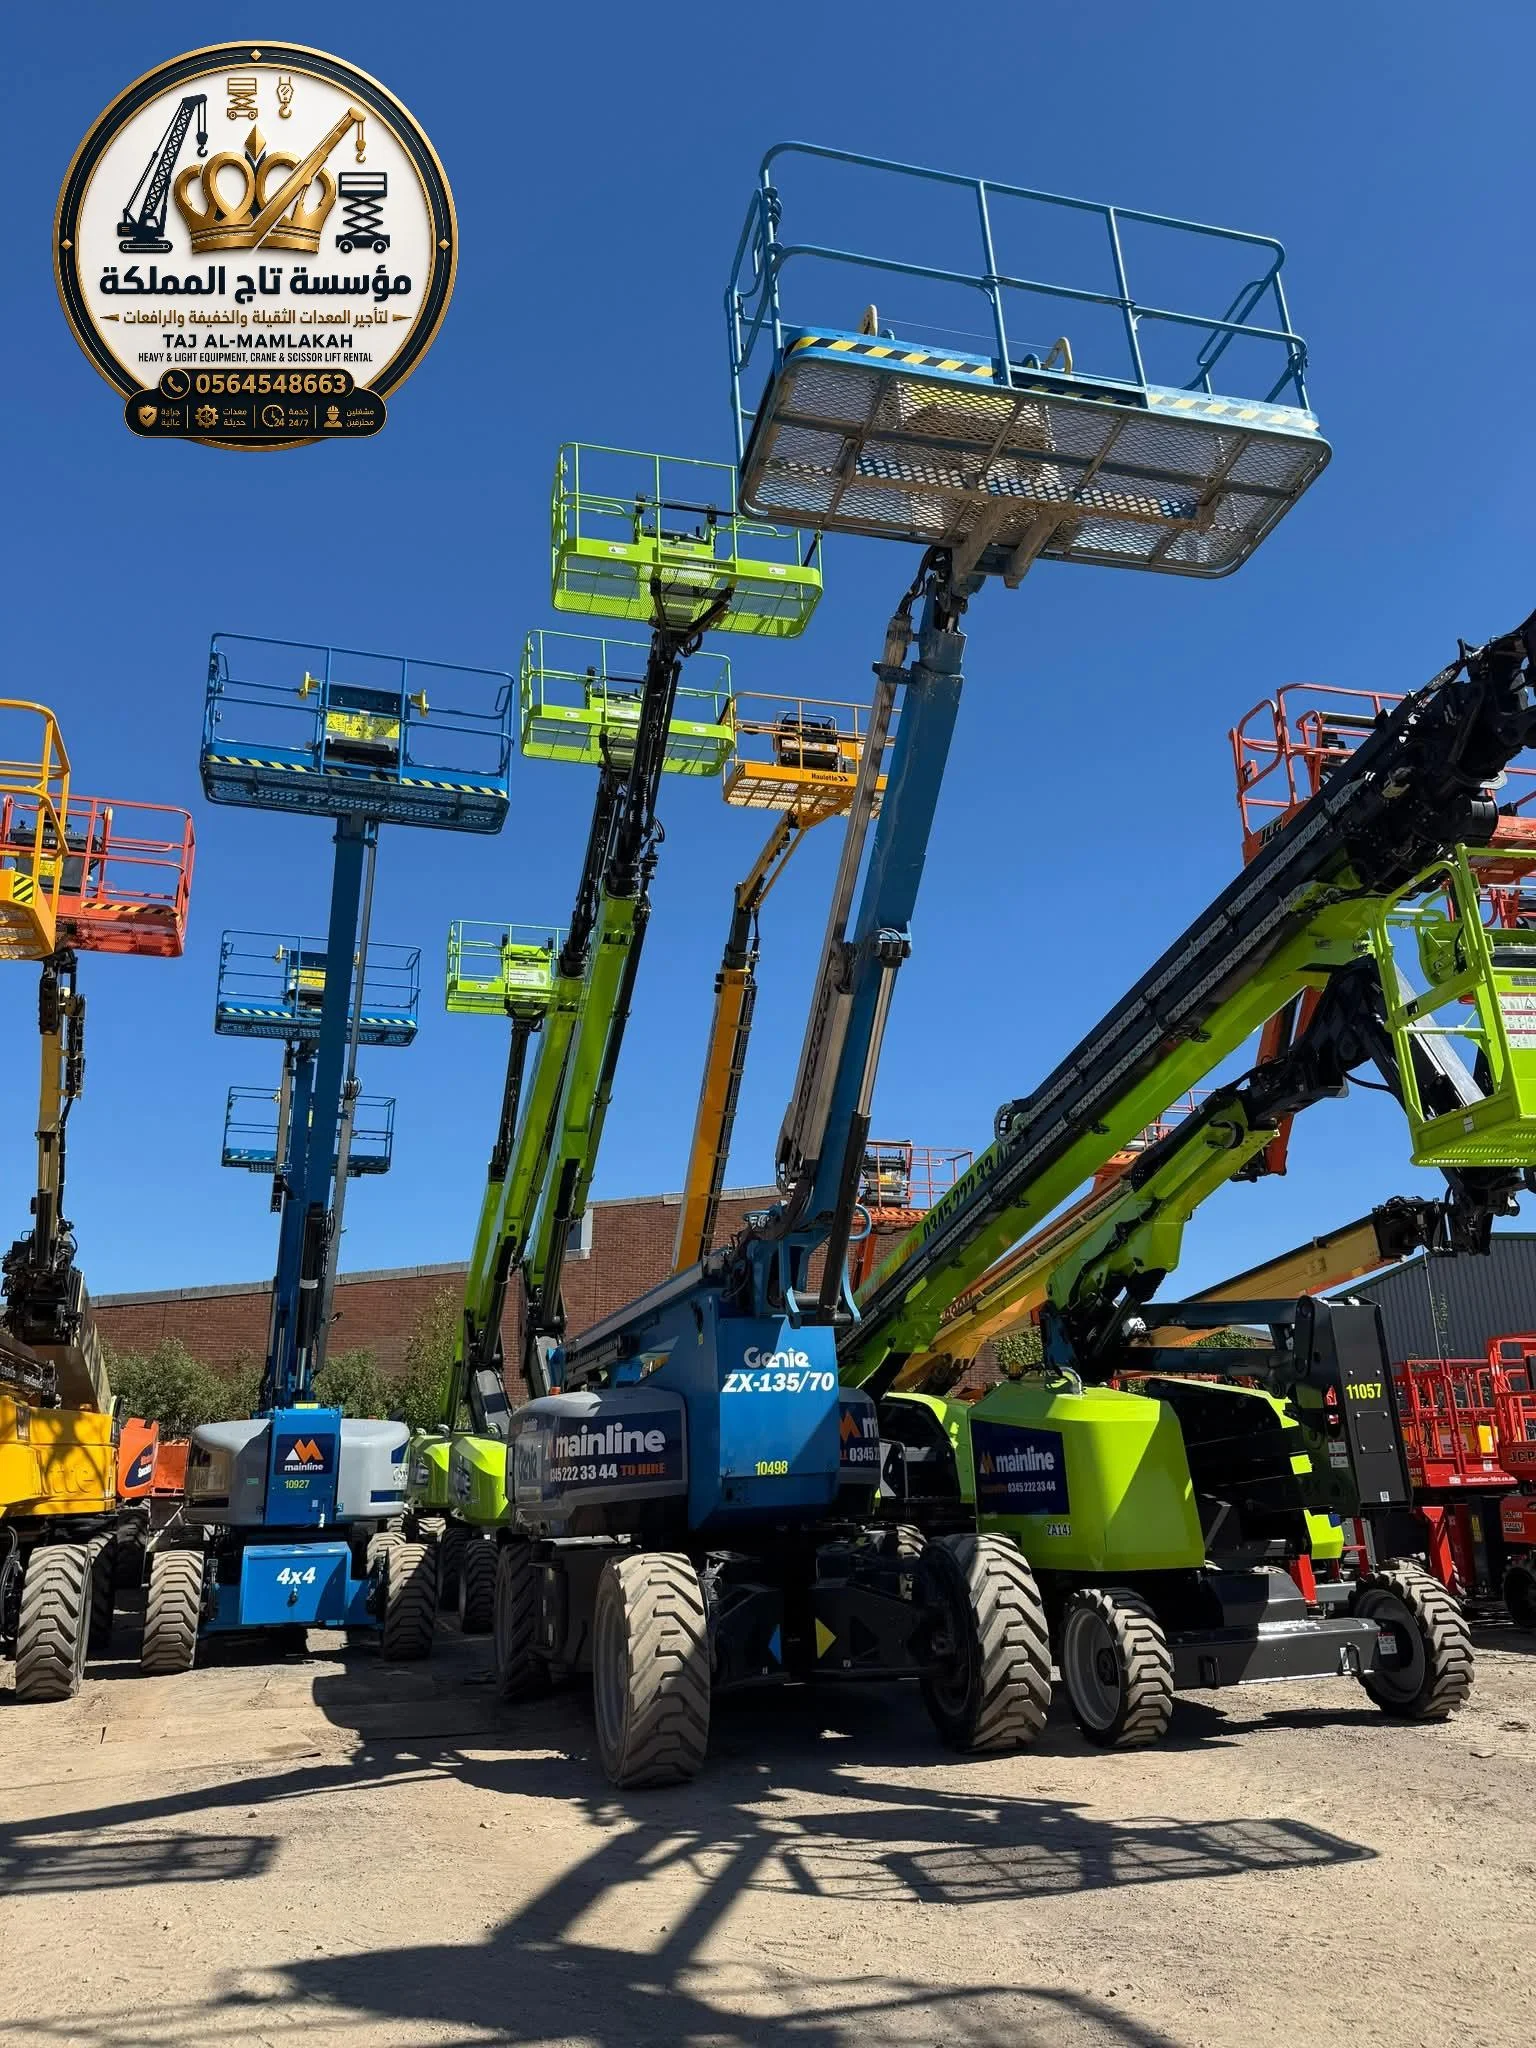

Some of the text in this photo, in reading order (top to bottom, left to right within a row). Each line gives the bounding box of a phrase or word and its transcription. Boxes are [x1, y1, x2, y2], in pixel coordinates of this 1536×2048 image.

[743, 1346, 811, 1369] Genie
[721, 1370, 836, 1393] ZX-135/70
[1345, 1383, 1382, 1400] 11057
[555, 1422, 666, 1460] mainline
[284, 1462, 324, 1472] mainline
[995, 1444, 1055, 1473] mainline
[580, 1464, 597, 1481] 33
[599, 1463, 618, 1480] 44
[754, 1460, 789, 1476] 10498
[284, 1479, 310, 1489] 10927
[275, 1566, 317, 1585] 4x4
